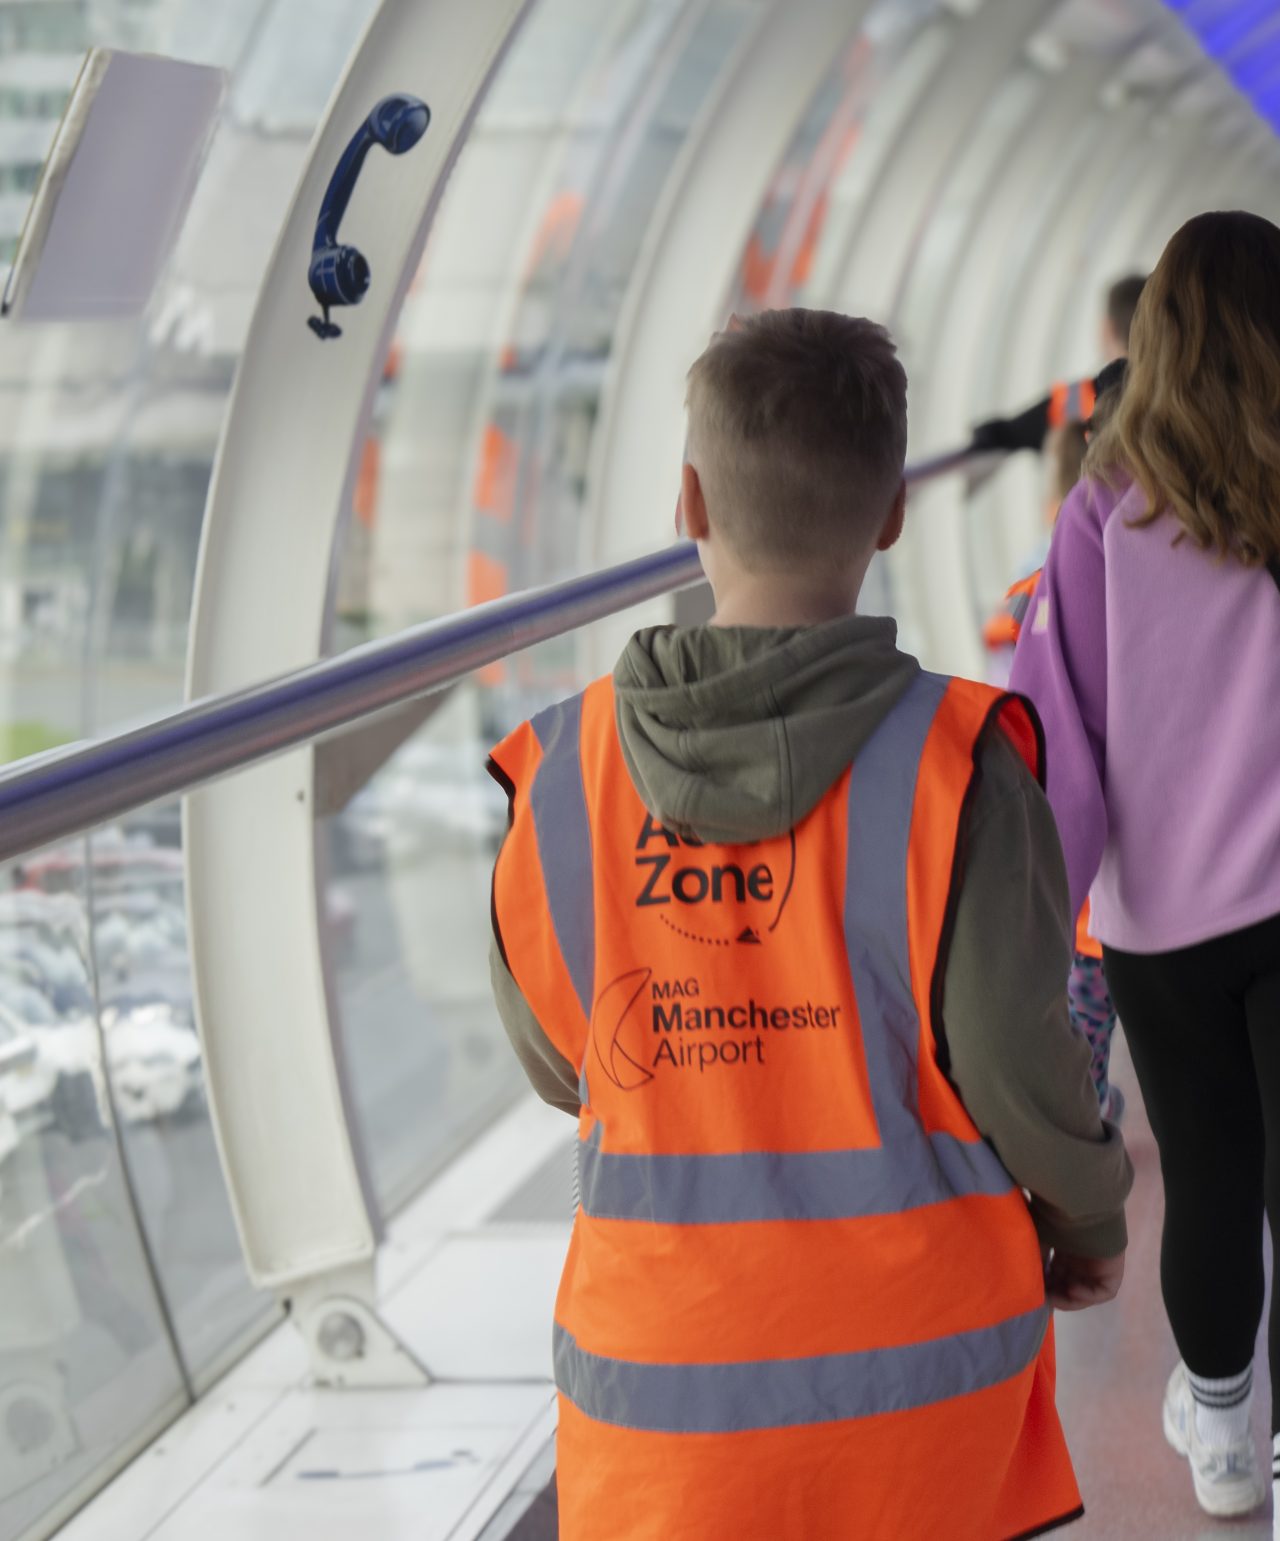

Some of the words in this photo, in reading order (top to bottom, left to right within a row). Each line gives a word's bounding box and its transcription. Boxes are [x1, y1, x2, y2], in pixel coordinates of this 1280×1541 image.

[635, 854, 774, 907] Zone
[652, 977, 700, 1000] MAG
[652, 998, 841, 1033] Manchester
[652, 1034, 765, 1074] Airport
